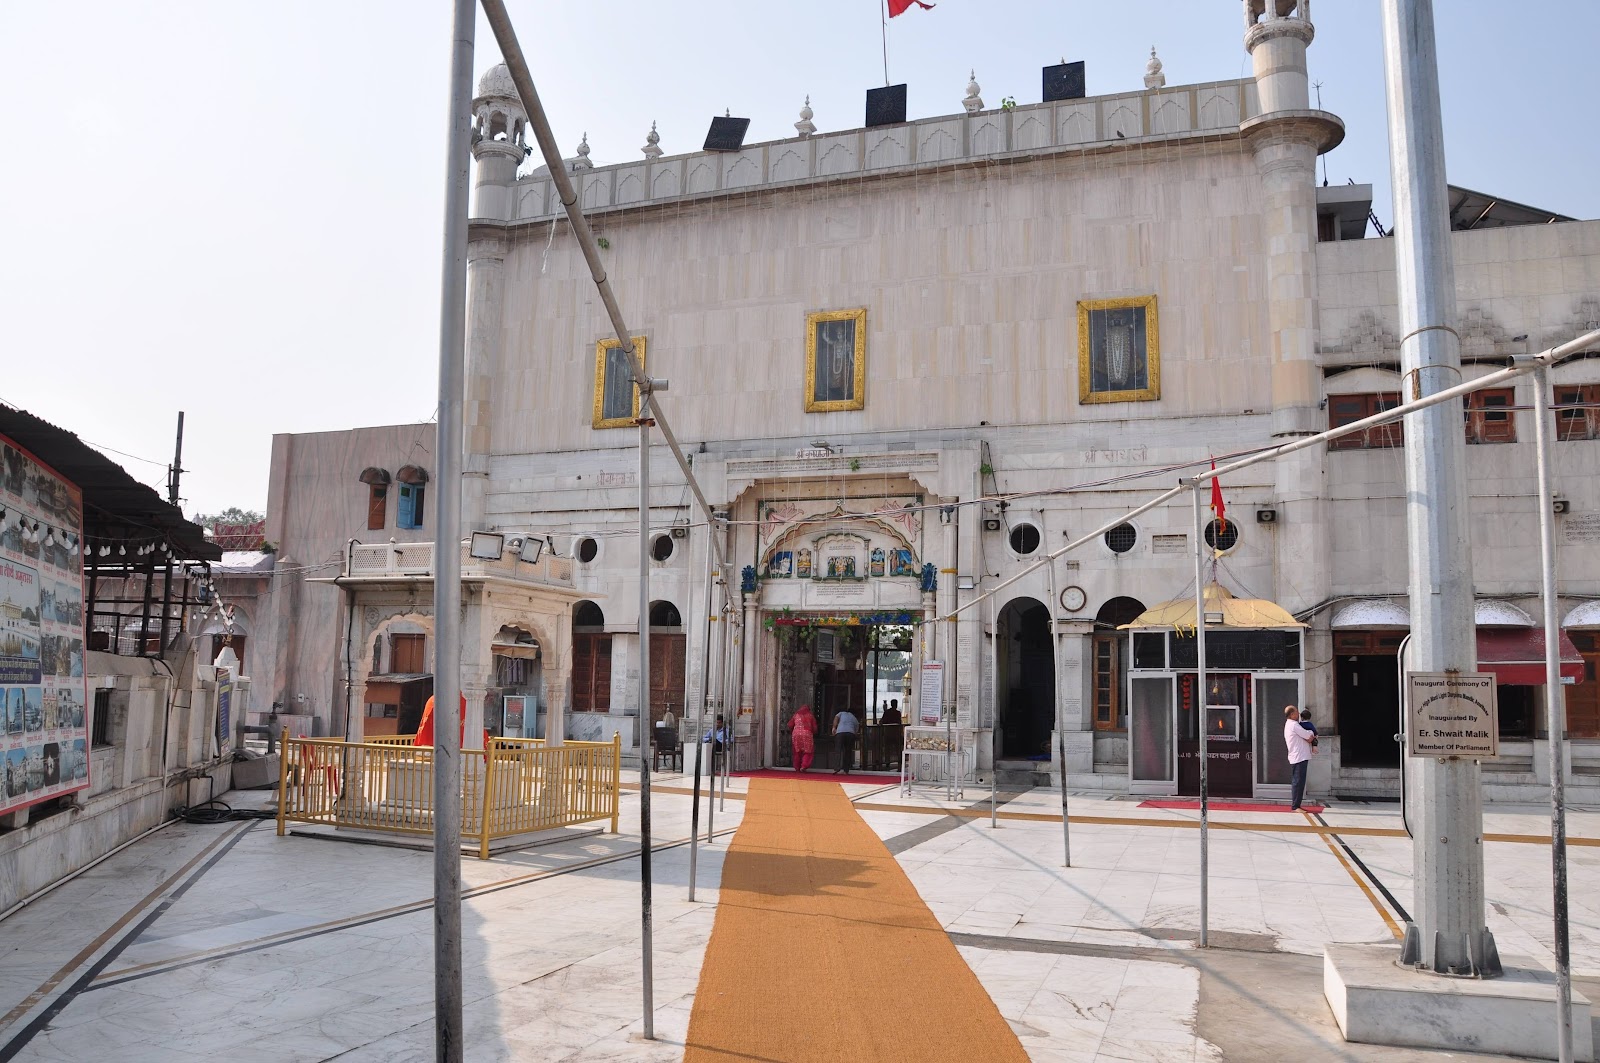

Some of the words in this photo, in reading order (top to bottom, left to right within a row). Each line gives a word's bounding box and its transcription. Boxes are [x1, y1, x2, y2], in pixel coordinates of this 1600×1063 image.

[1085, 446, 1096, 463] श्री
[1433, 729, 1463, 738] Shwait
[1466, 730, 1489, 738] Malik
